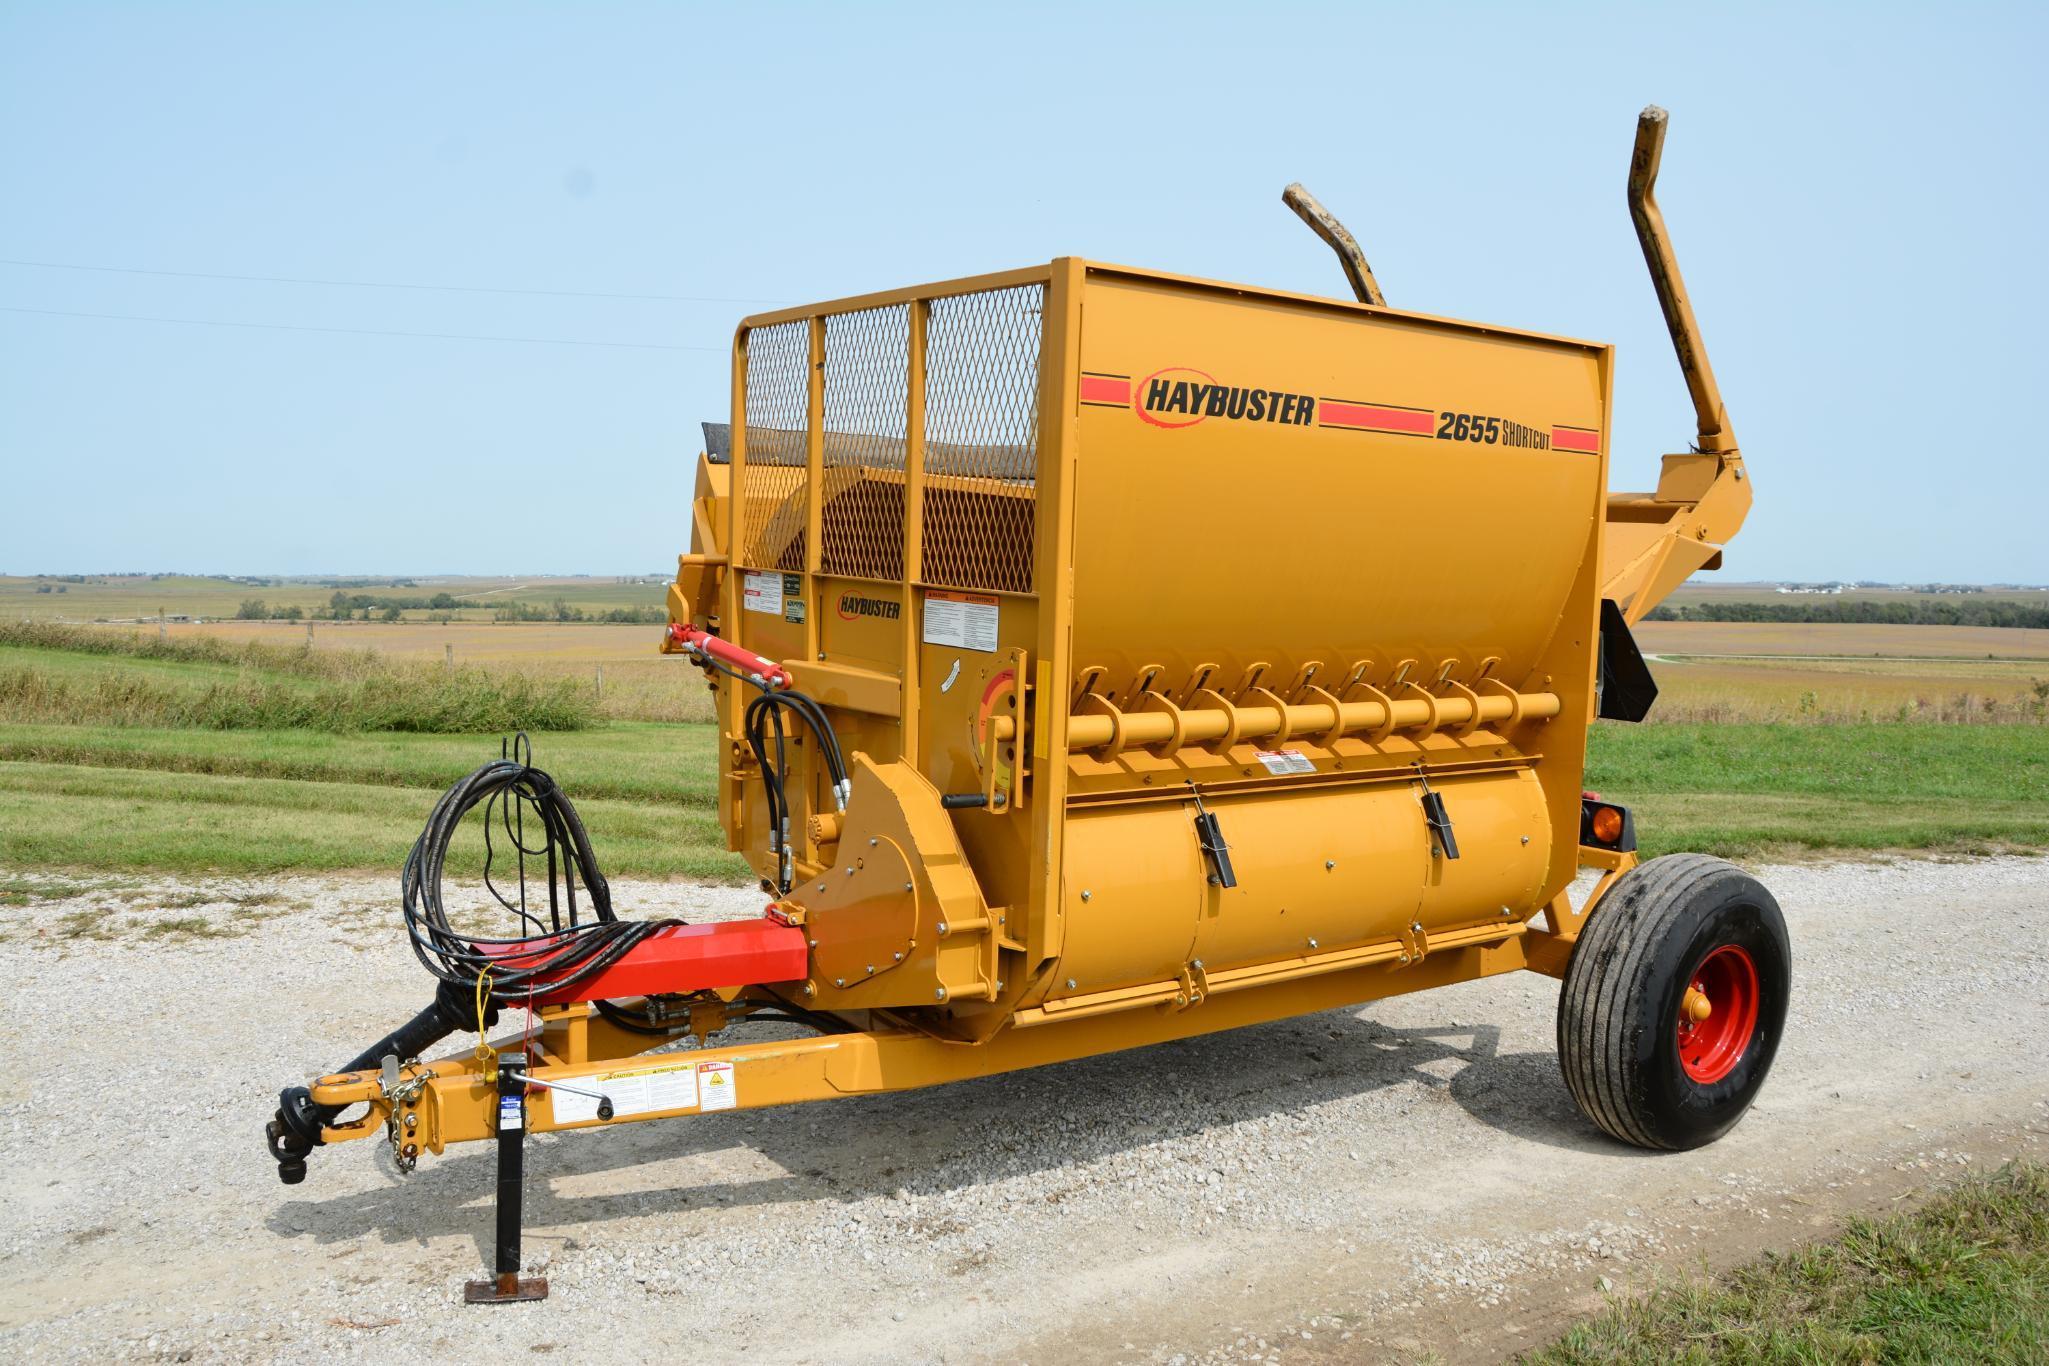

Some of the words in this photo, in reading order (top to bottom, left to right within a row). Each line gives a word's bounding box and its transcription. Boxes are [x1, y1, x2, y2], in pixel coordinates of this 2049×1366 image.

[1145, 378, 1315, 426] HAYBUSTER
[1436, 411, 1501, 445] 2655
[1502, 419, 1551, 451] SHORTCUT
[840, 596, 901, 620] HAYBUSTER
